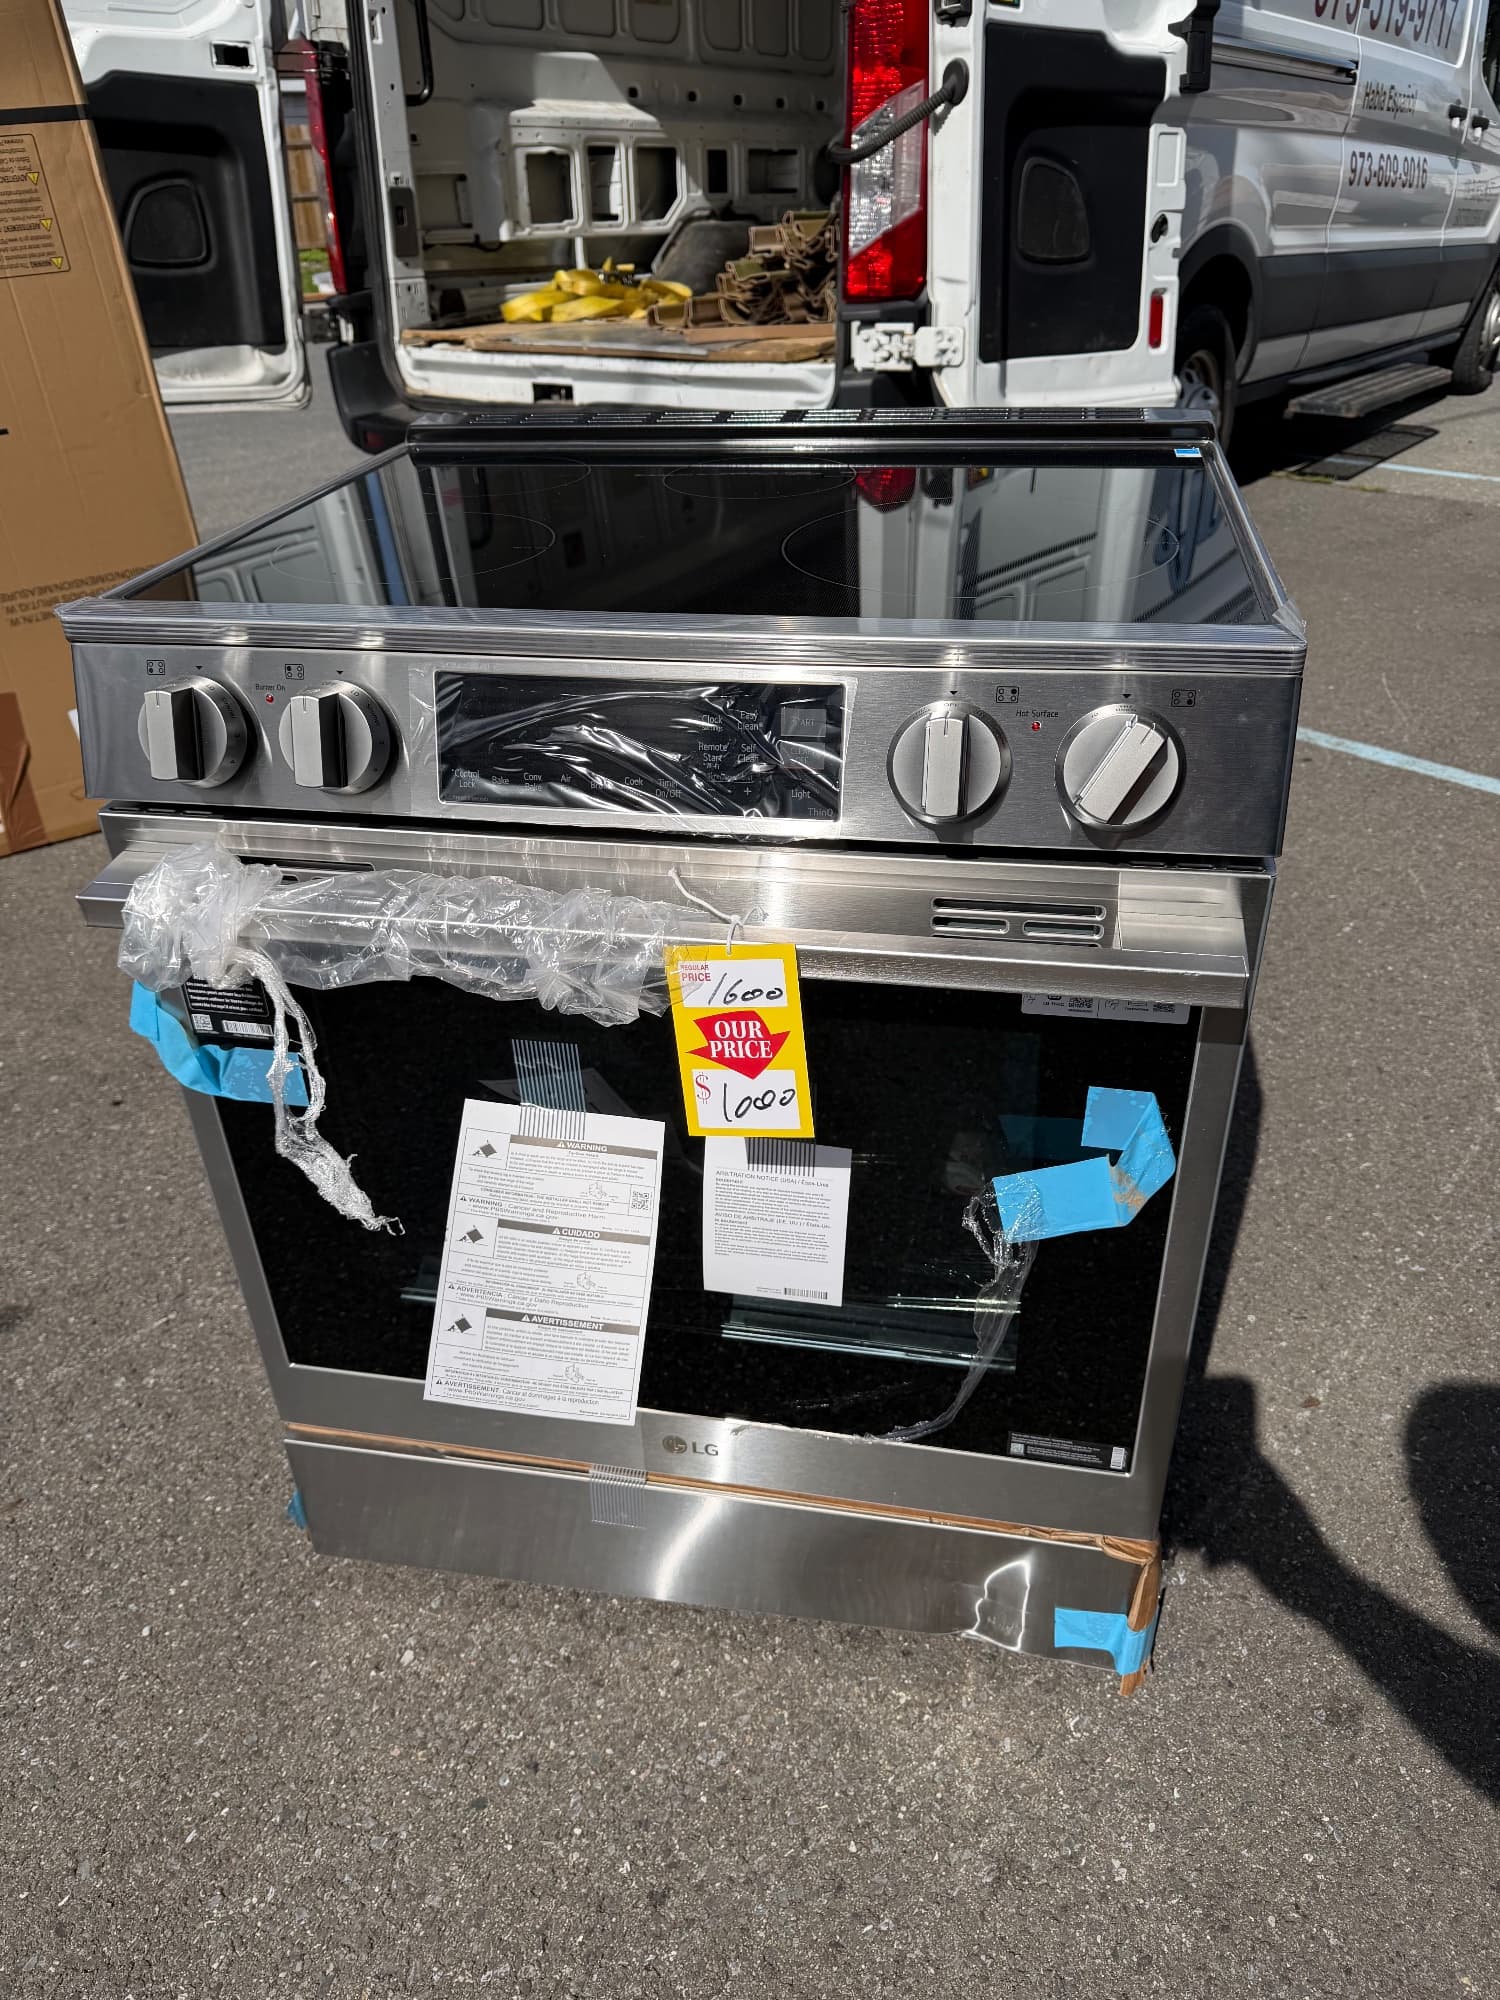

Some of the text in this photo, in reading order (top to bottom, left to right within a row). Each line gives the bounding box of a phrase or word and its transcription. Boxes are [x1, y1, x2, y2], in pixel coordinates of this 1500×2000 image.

[1348, 150, 1429, 190] 973-609-9016
[256, 683, 286, 692] Burner On
[1016, 709, 1059, 718] Hot Surface
[702, 715, 723, 725] Clock
[698, 742, 729, 752] Remote
[741, 743, 757, 753] Self
[703, 753, 723, 762] Start
[737, 753, 759, 763] Clean
[459, 779, 476, 788] Lock
[491, 775, 510, 784] Bake
[560, 774, 572, 783] Air
[624, 776, 644, 786] Cook
[655, 788, 682, 799] On/Off
[791, 789, 811, 799] Light
[807, 807, 834, 817] ThinQ
[681, 972, 711, 982] PRICE
[707, 972, 784, 1005] 1600
[714, 1020, 763, 1039] OUR
[709, 1040, 773, 1059] PRICE
[695, 1071, 796, 1123] $ 1000
[566, 1141, 608, 1152] WARNING
[756, 1174, 778, 1182] NOTICE
[561, 1228, 600, 1239] CUIDADO
[531, 1315, 604, 1330] AVERTISSEMENT
[691, 1441, 719, 1456] LG
